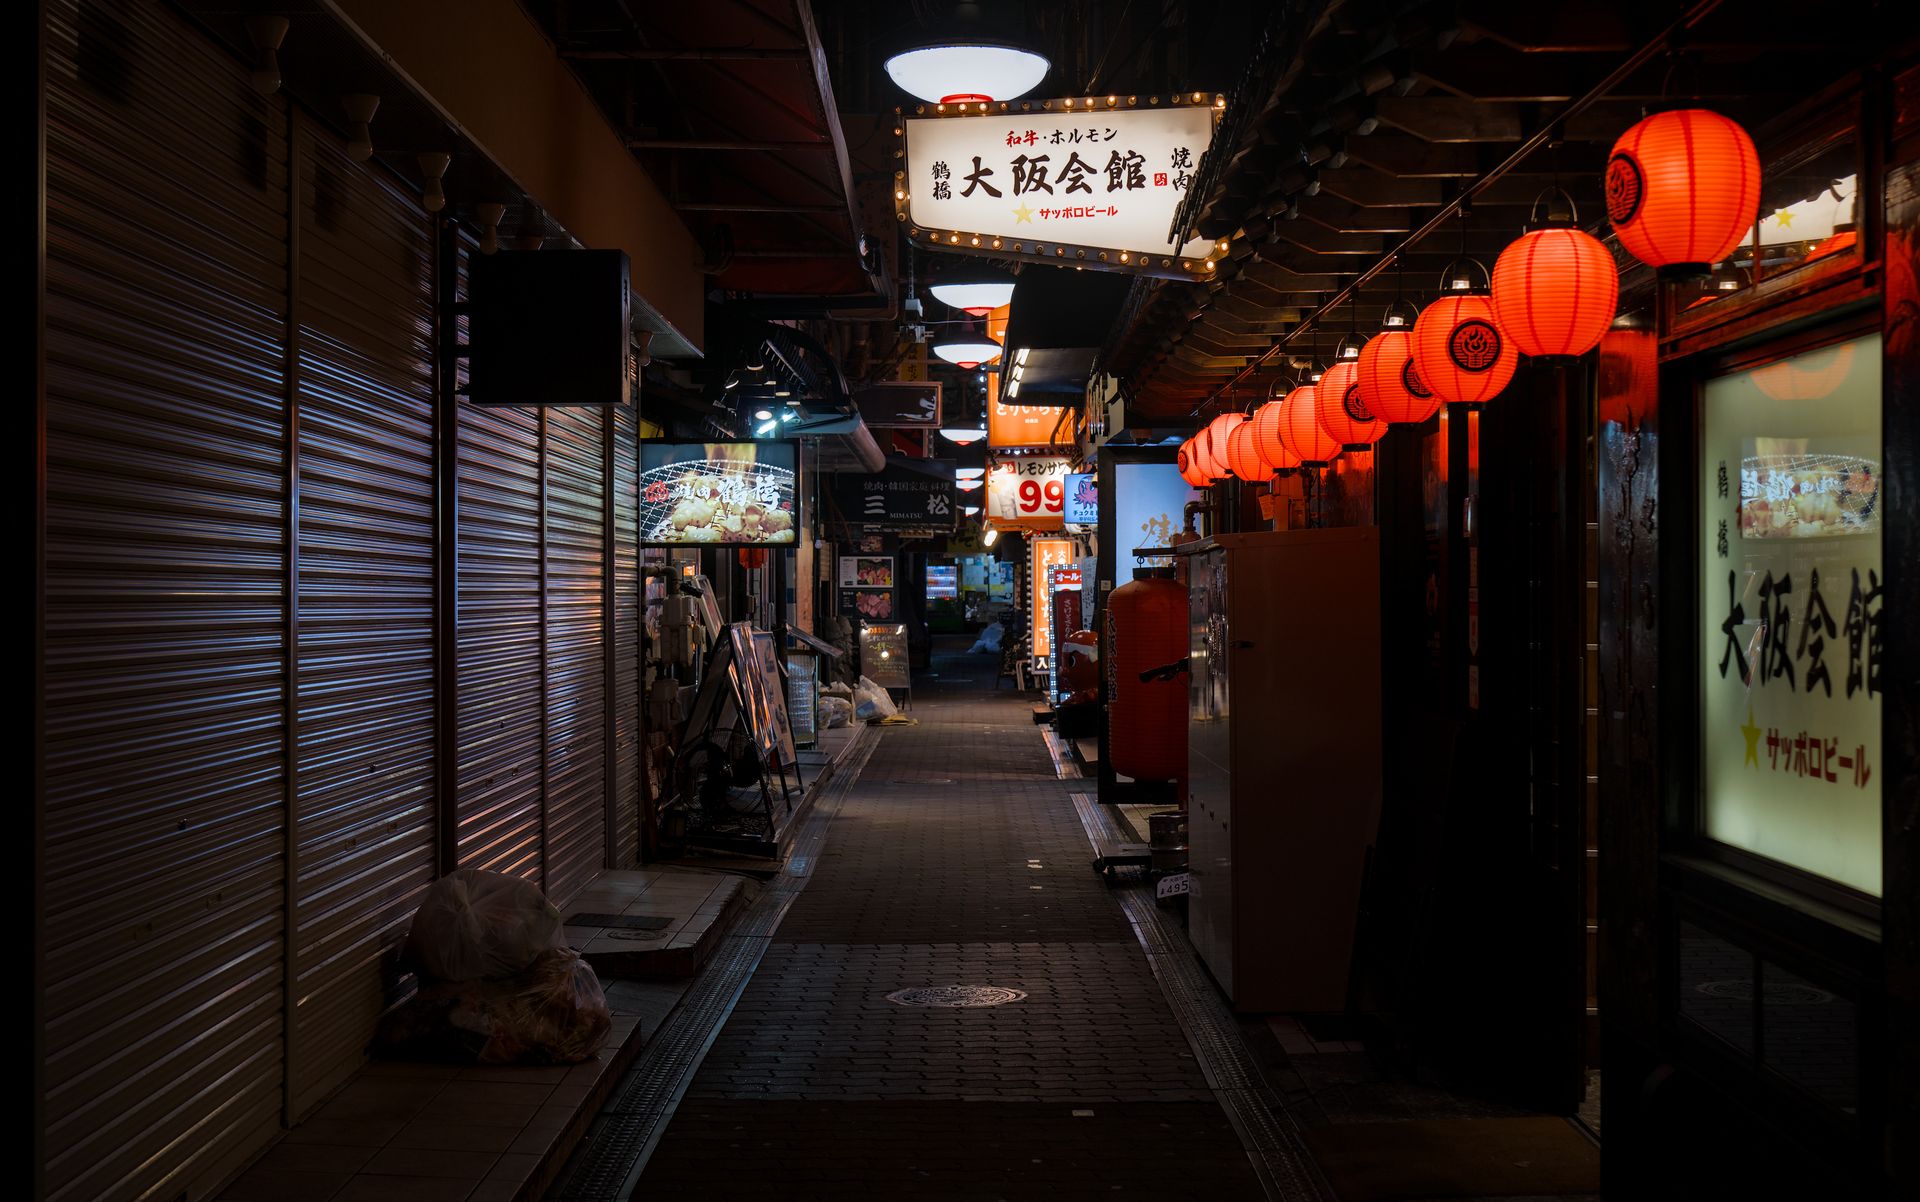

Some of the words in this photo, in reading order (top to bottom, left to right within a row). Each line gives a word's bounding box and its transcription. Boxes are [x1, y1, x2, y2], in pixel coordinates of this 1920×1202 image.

[932, 160, 952, 201] 鶴橋
[960, 149, 1147, 198] 大阪会館
[1170, 147, 1194, 191] 焼肉
[1039, 204, 1119, 220] サッポロビール
[1718, 567, 1882, 700] 大阪会館
[1766, 727, 1872, 790] サッポロビール
